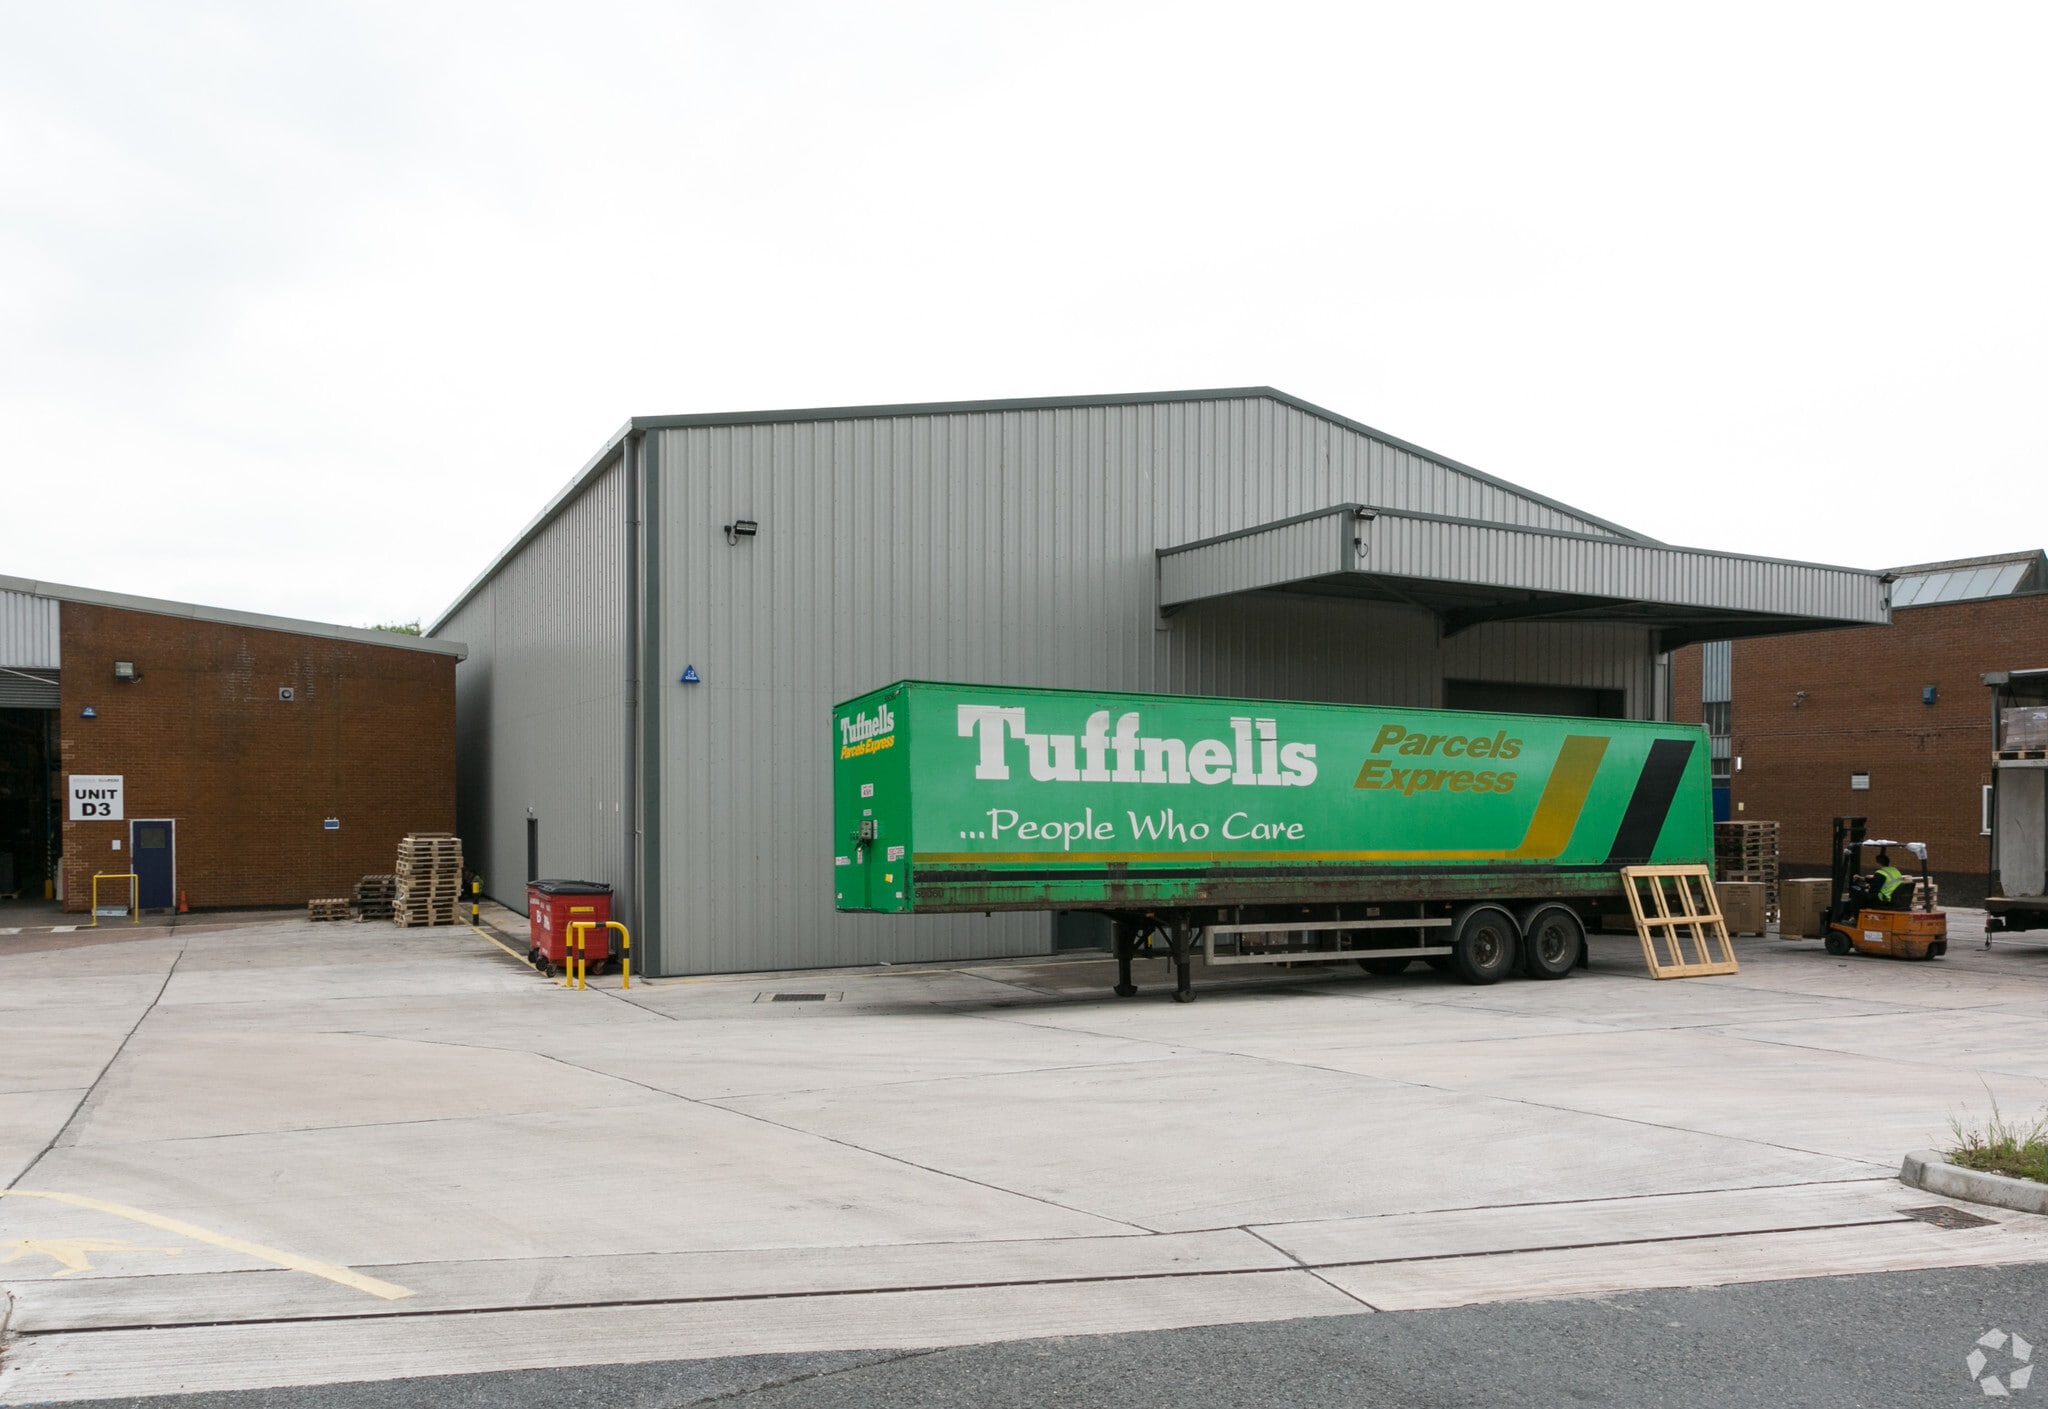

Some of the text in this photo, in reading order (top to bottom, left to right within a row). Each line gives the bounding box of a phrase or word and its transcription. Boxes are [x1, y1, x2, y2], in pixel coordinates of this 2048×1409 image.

[841, 704, 894, 745] Tuffnells
[1370, 724, 1523, 760] Parcels
[840, 735, 894, 759] Parcels Express
[957, 704, 1318, 786] Tuffnells
[75, 789, 117, 799] UNIT
[1353, 759, 1518, 796] Express
[82, 803, 111, 816] D3
[1126, 807, 1210, 841] Who
[1221, 811, 1306, 841] Care
